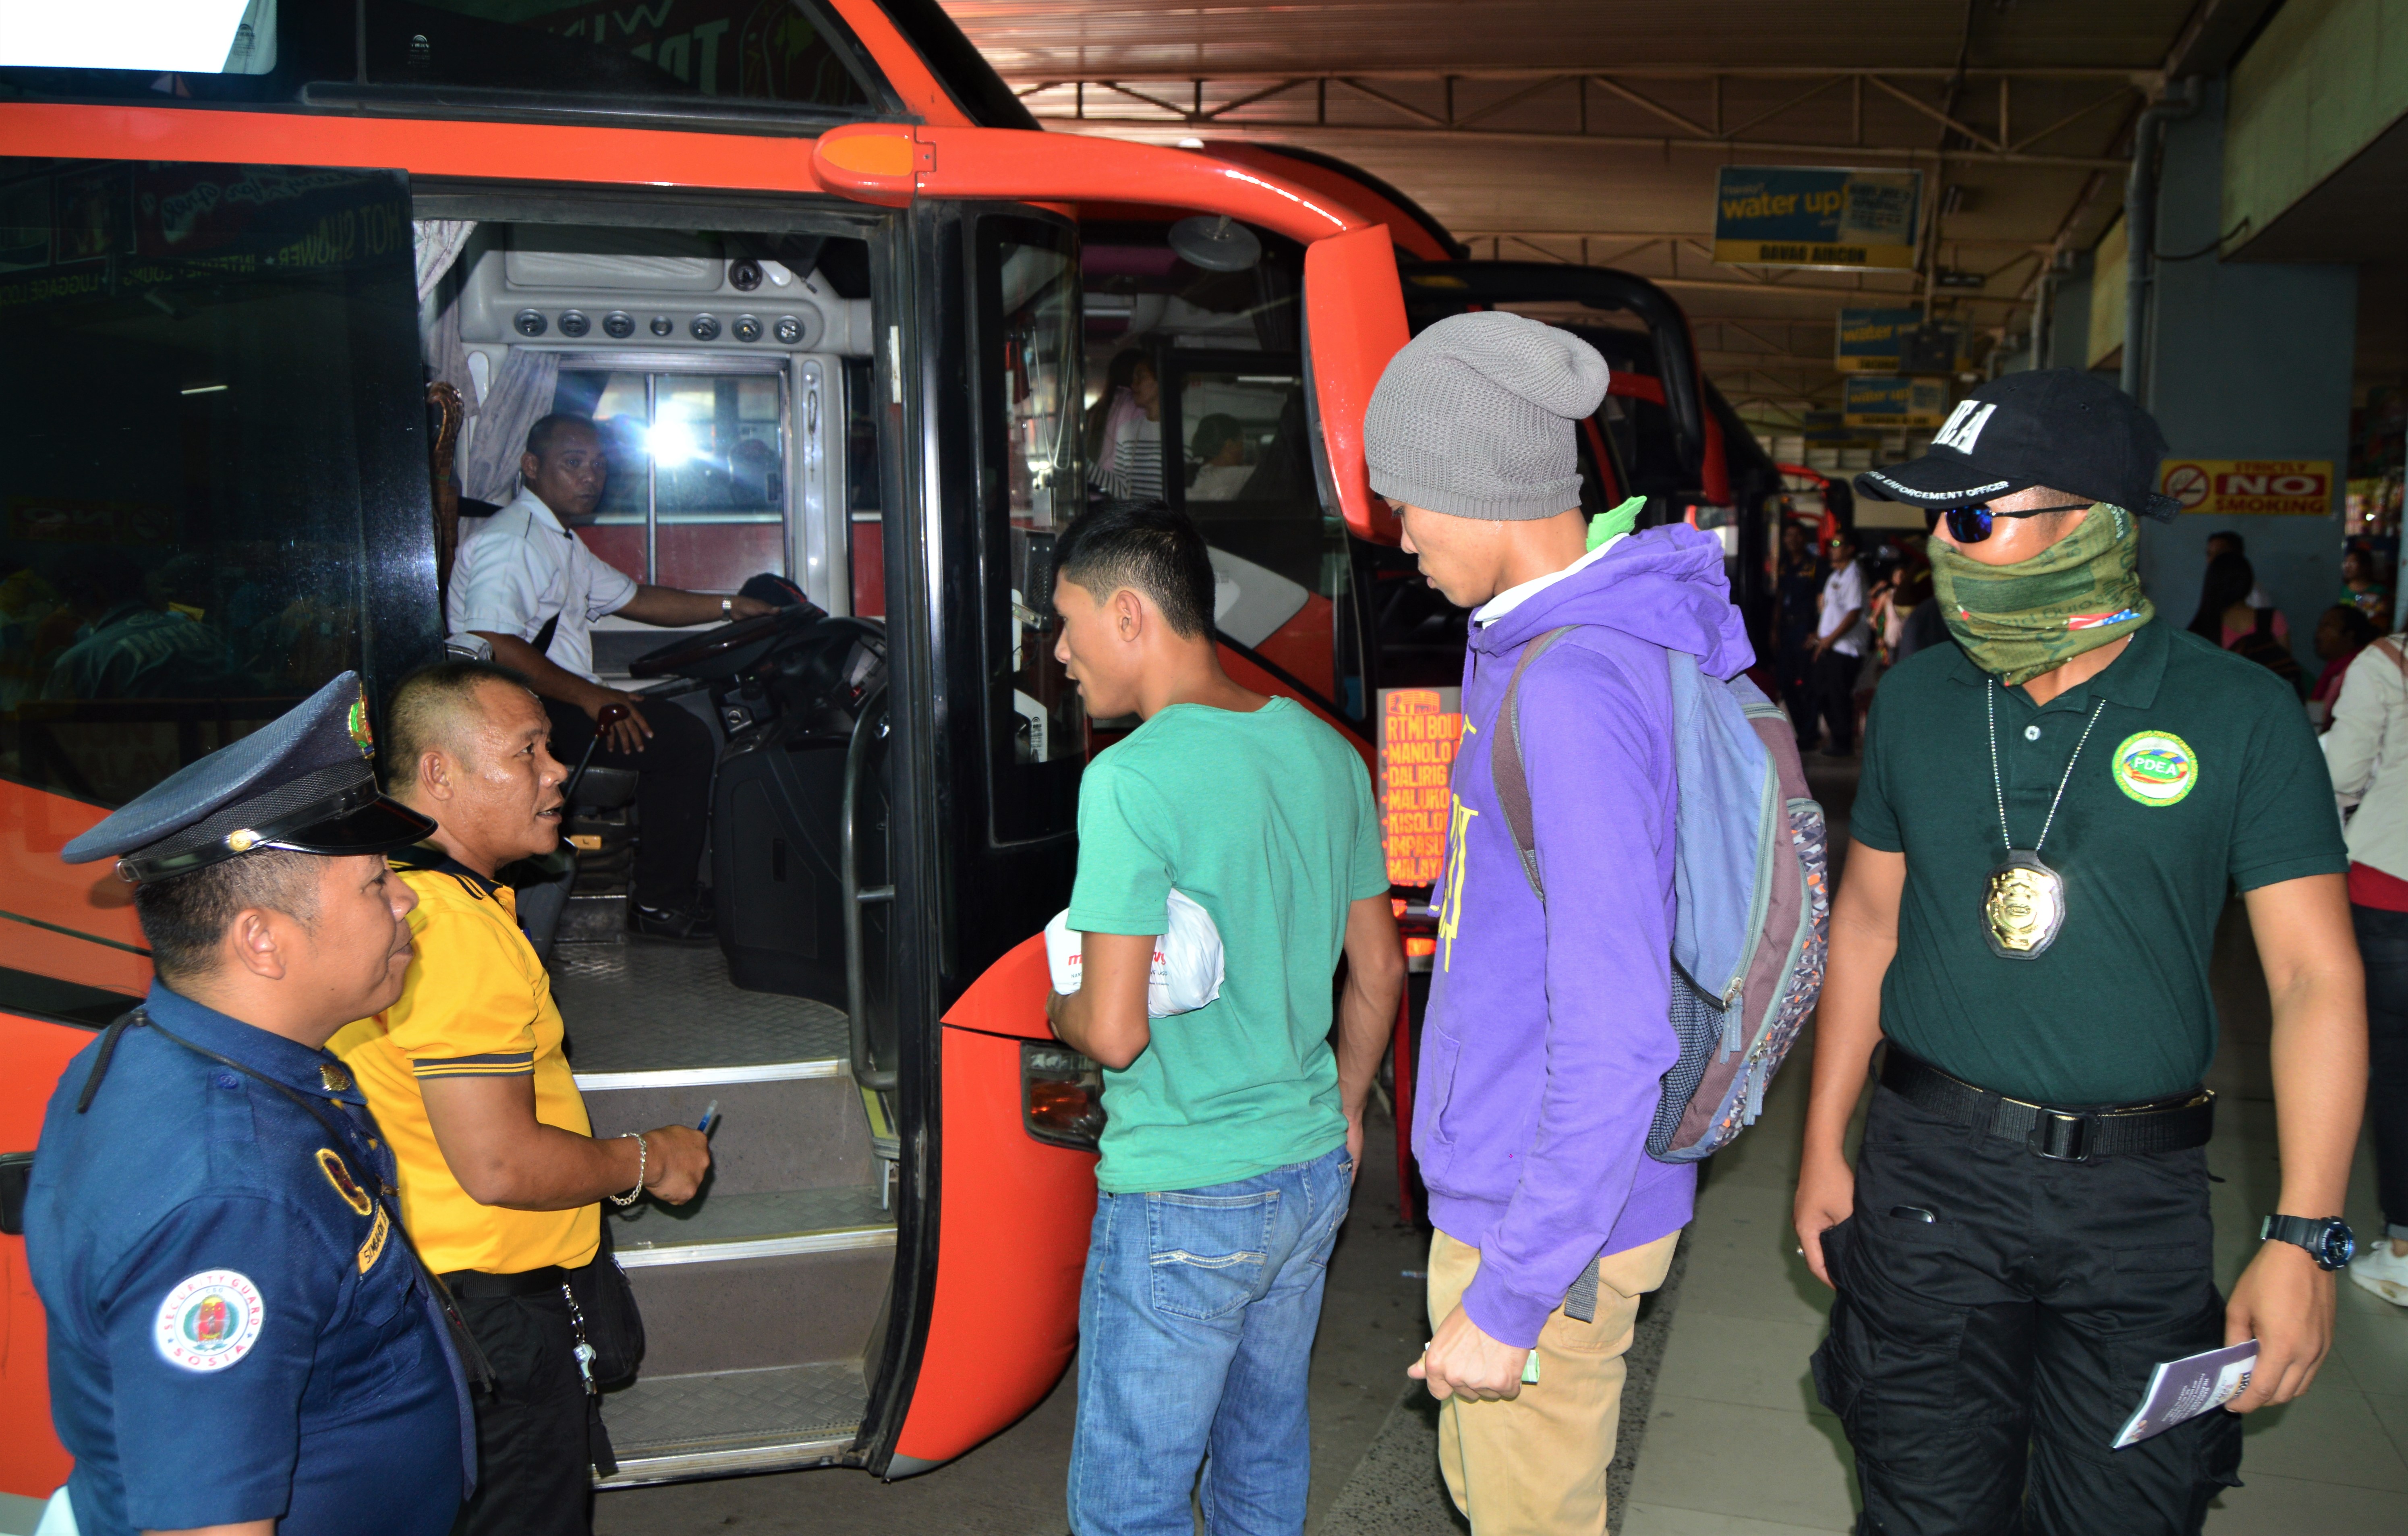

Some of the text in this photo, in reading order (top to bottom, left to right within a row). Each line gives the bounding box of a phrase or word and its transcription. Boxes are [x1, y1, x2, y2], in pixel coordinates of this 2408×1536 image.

[1722, 192, 1799, 220] water
[1804, 184, 1850, 216] up!
[1882, 479, 1964, 500] ENFORCEMENT
[1965, 481, 2010, 497] OFFICER
[2225, 475, 2318, 495] NO
[2216, 497, 2325, 513] SMOKING
[1386, 715, 1425, 741] RTMI
[1388, 741, 1452, 765] MANOLO
[1388, 764, 1448, 787] DALIRIG
[2134, 757, 2177, 776] PDEA
[1388, 788, 1451, 810] MALUKO
[164, 1275, 261, 1330] SECURITY GUARD
[173, 1345, 247, 1366] SOSIA
